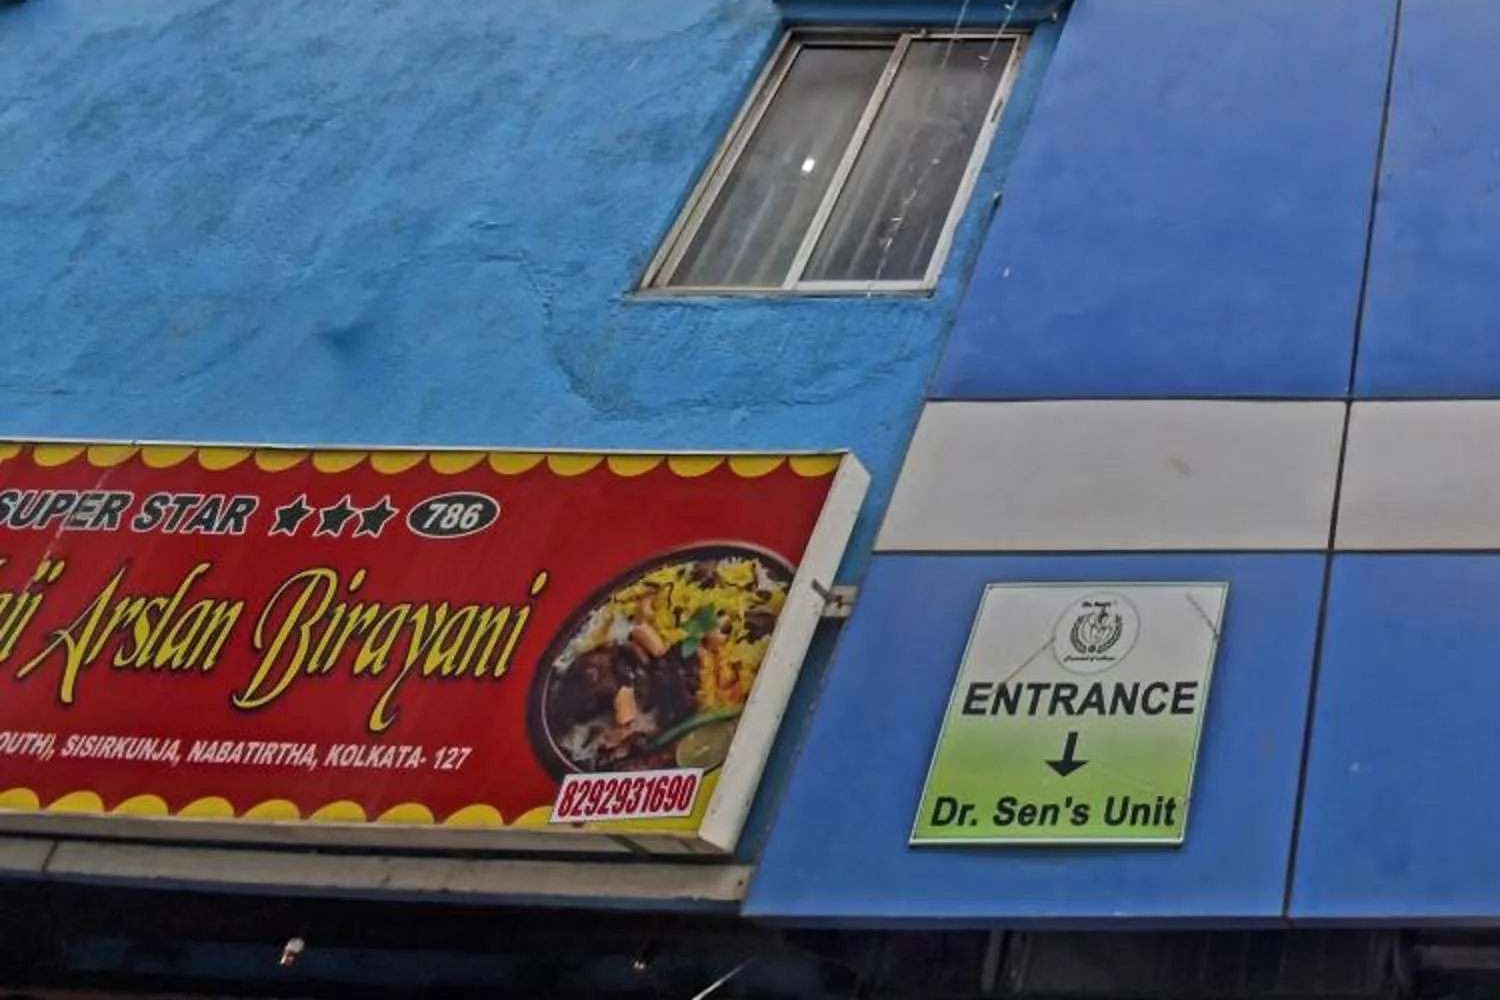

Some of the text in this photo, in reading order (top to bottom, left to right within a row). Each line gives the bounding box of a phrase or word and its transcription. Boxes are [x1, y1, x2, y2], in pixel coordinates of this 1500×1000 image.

[0, 488, 484, 535] SUPER STAR 786
[16, 563, 245, 703] Arslan
[233, 568, 548, 731] Birayani
[961, 681, 1199, 716] ENTRANCE
[61, 734, 182, 767] SISIRKUNJA,
[187, 740, 318, 771] NABATIRTHA,
[433, 747, 472, 770] 127
[558, 774, 696, 817] 8292931690
[930, 796, 1178, 827] Dr. Sen's Unit
